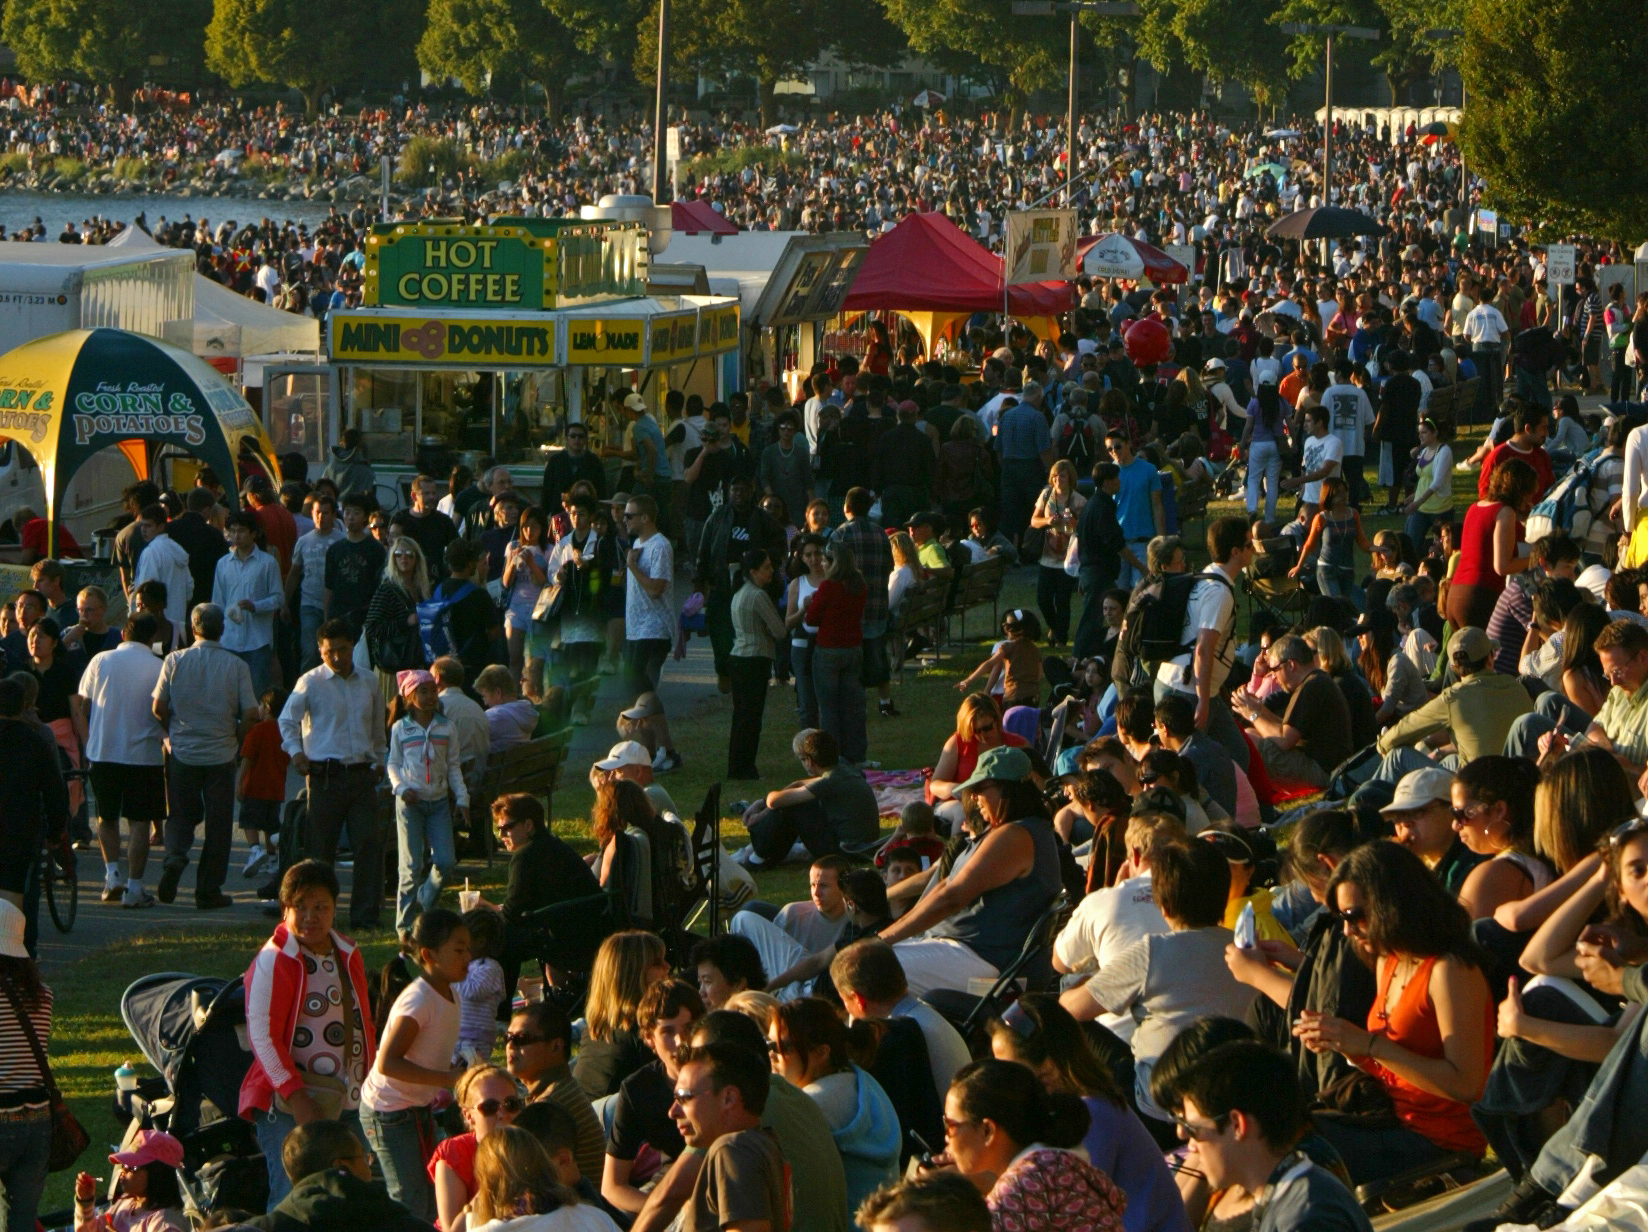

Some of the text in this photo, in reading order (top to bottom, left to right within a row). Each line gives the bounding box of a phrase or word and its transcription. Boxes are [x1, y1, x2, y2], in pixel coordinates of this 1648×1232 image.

[424, 239, 499, 269] HOT
[397, 271, 524, 303] COFFEE
[339, 322, 550, 357] MINI DONUTS
[33, 390, 54, 411] &
[96, 381, 165, 393] Fresh Roasted
[75, 392, 195, 414] CORN &
[73, 414, 206, 445] POTATOES
